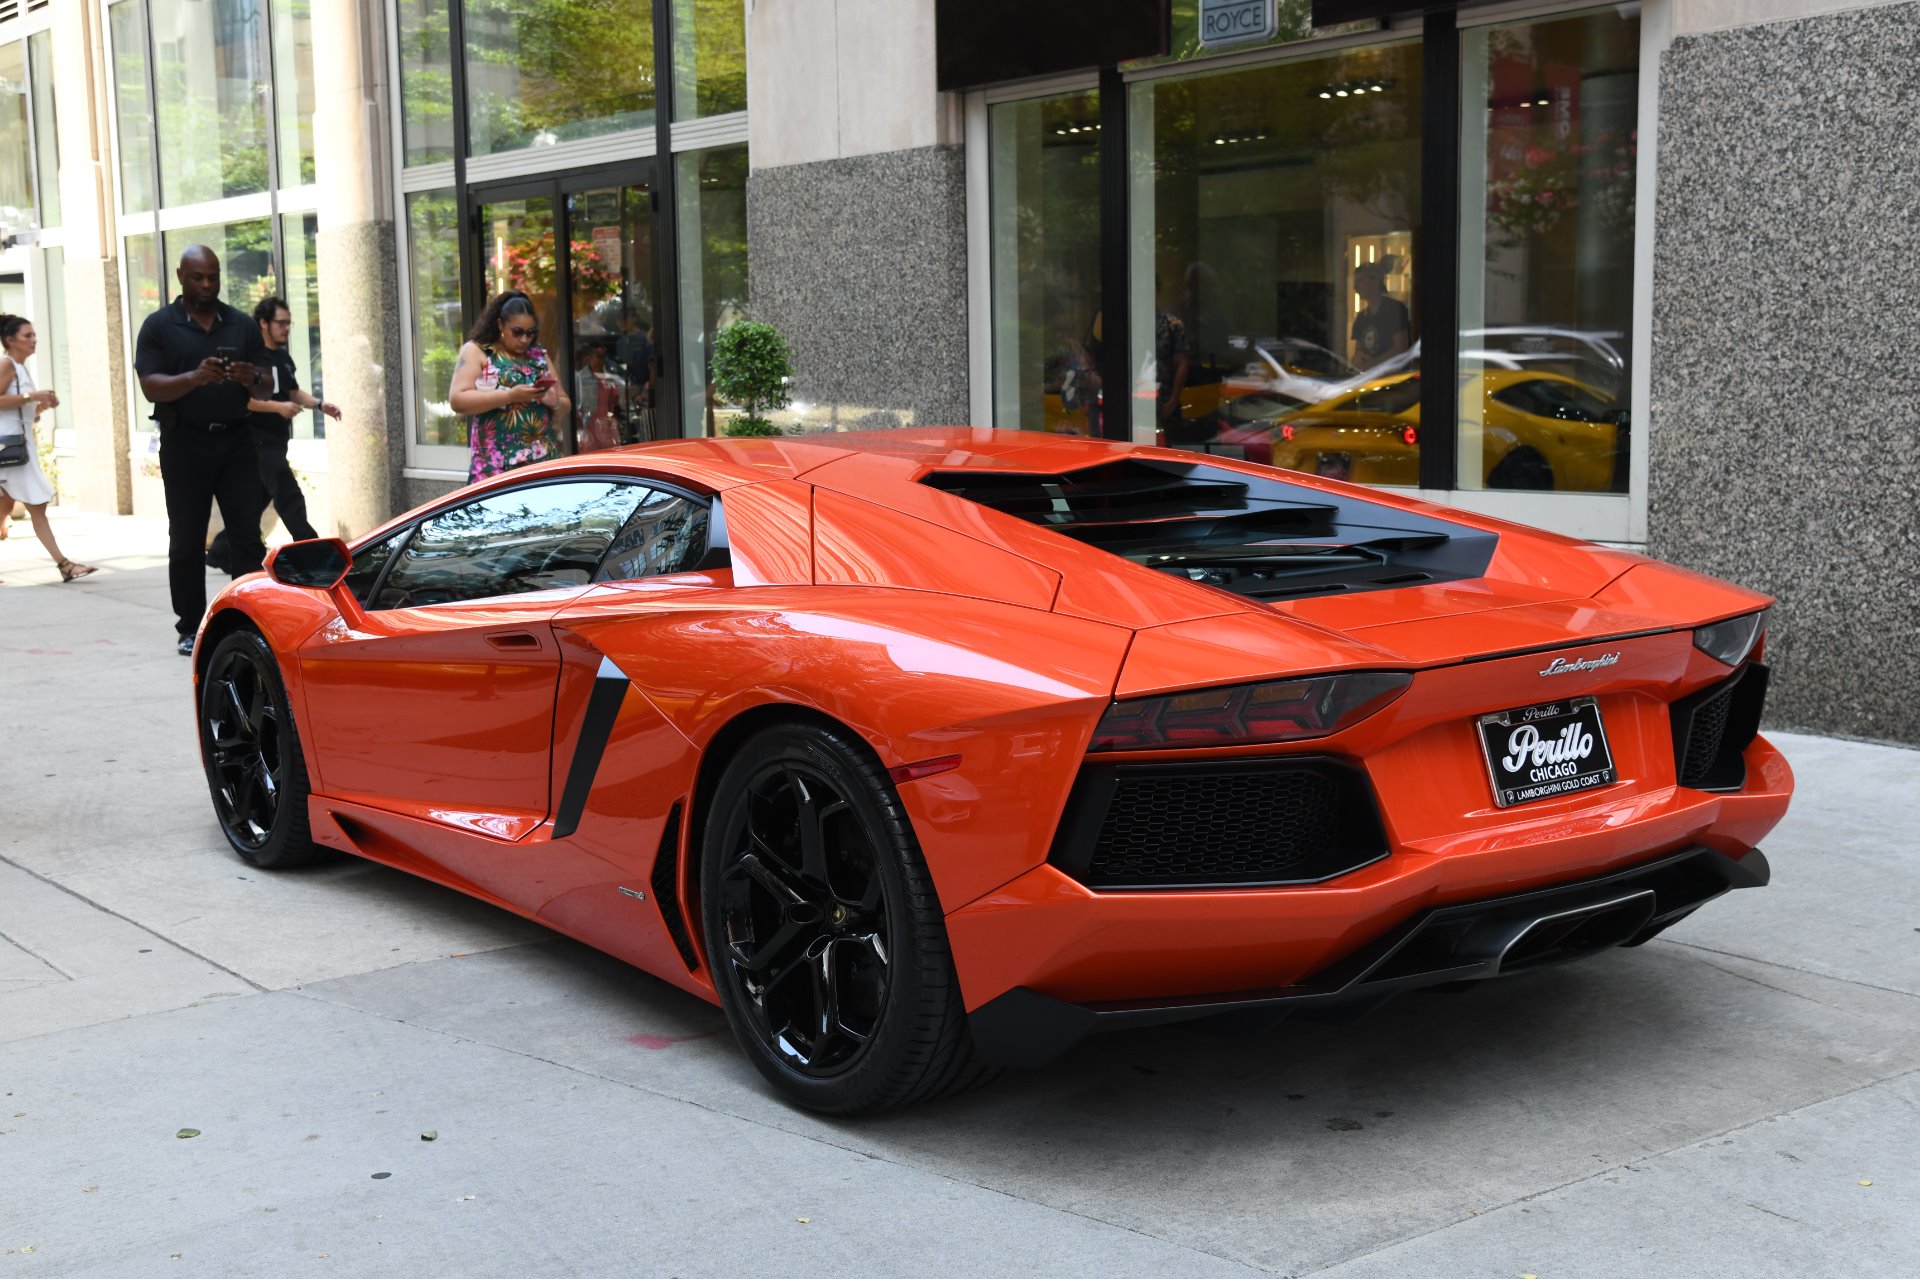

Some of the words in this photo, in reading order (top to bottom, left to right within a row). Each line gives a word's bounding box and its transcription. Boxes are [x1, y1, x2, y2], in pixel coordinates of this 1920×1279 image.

[1207, 6, 1260, 33] ROYCE
[1539, 652, 1620, 676] Lamborghini
[1522, 704, 1560, 721] Perillo
[1502, 721, 1593, 773] Perillo
[1530, 761, 1577, 783] CHICAGO
[1516, 783, 1562, 801] LAMBORGHINI
[1561, 779, 1580, 791] GOLD
[1580, 774, 1600, 787] COAST
